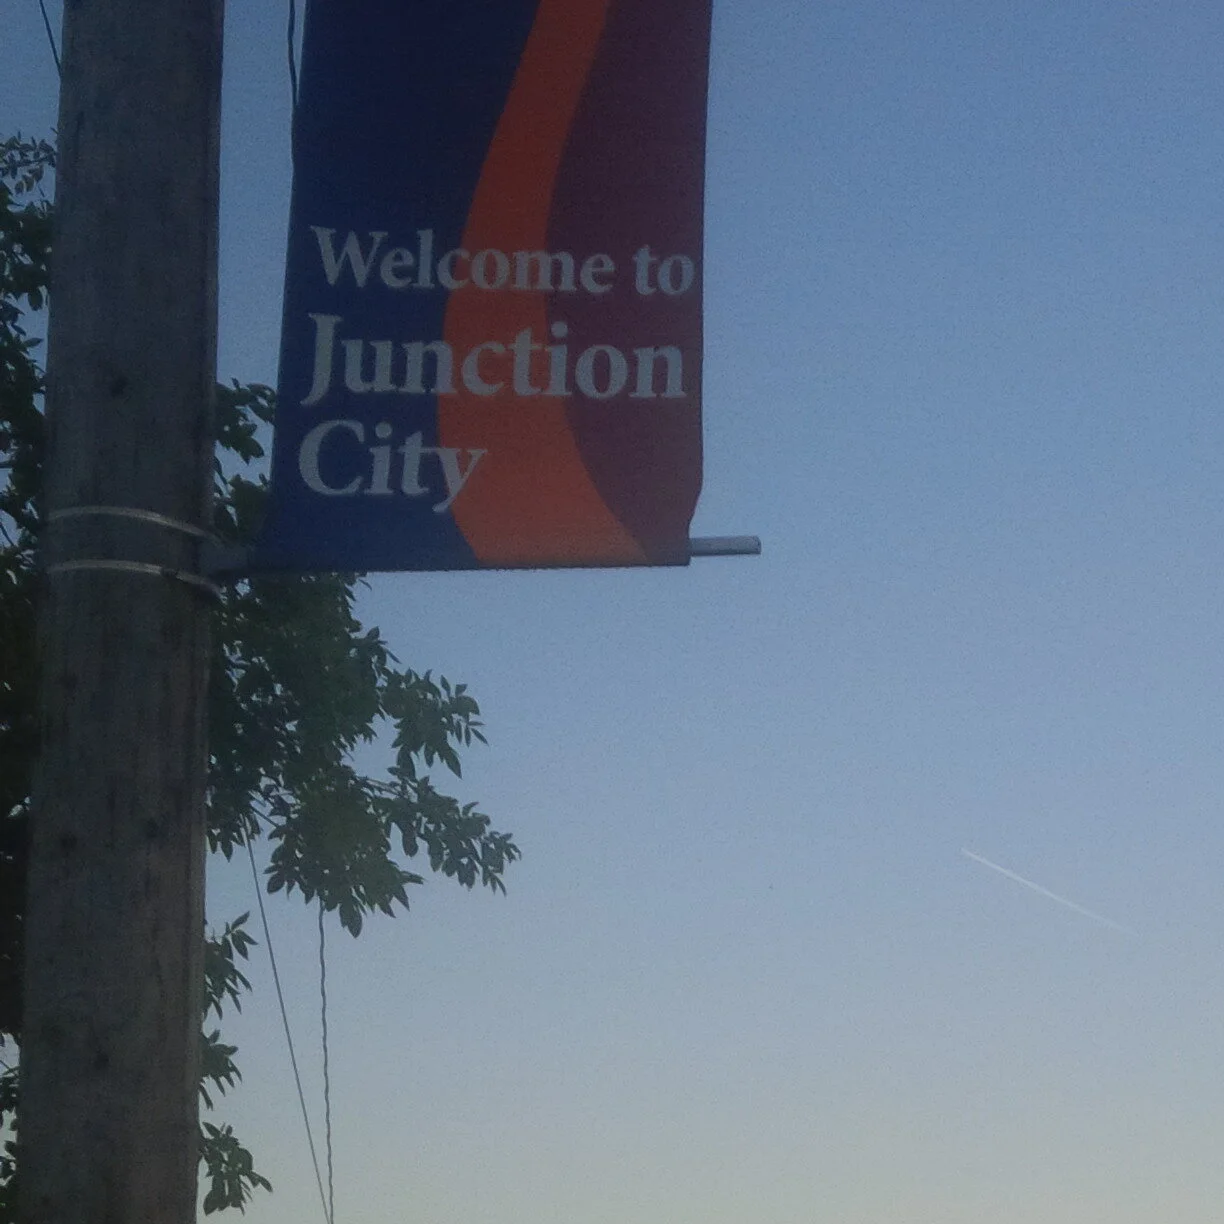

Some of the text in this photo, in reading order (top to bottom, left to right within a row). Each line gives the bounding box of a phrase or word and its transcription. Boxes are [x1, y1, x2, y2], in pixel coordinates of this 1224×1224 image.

[310, 225, 696, 296] Welcome to
[300, 312, 688, 406] Junction
[299, 419, 488, 513] City
